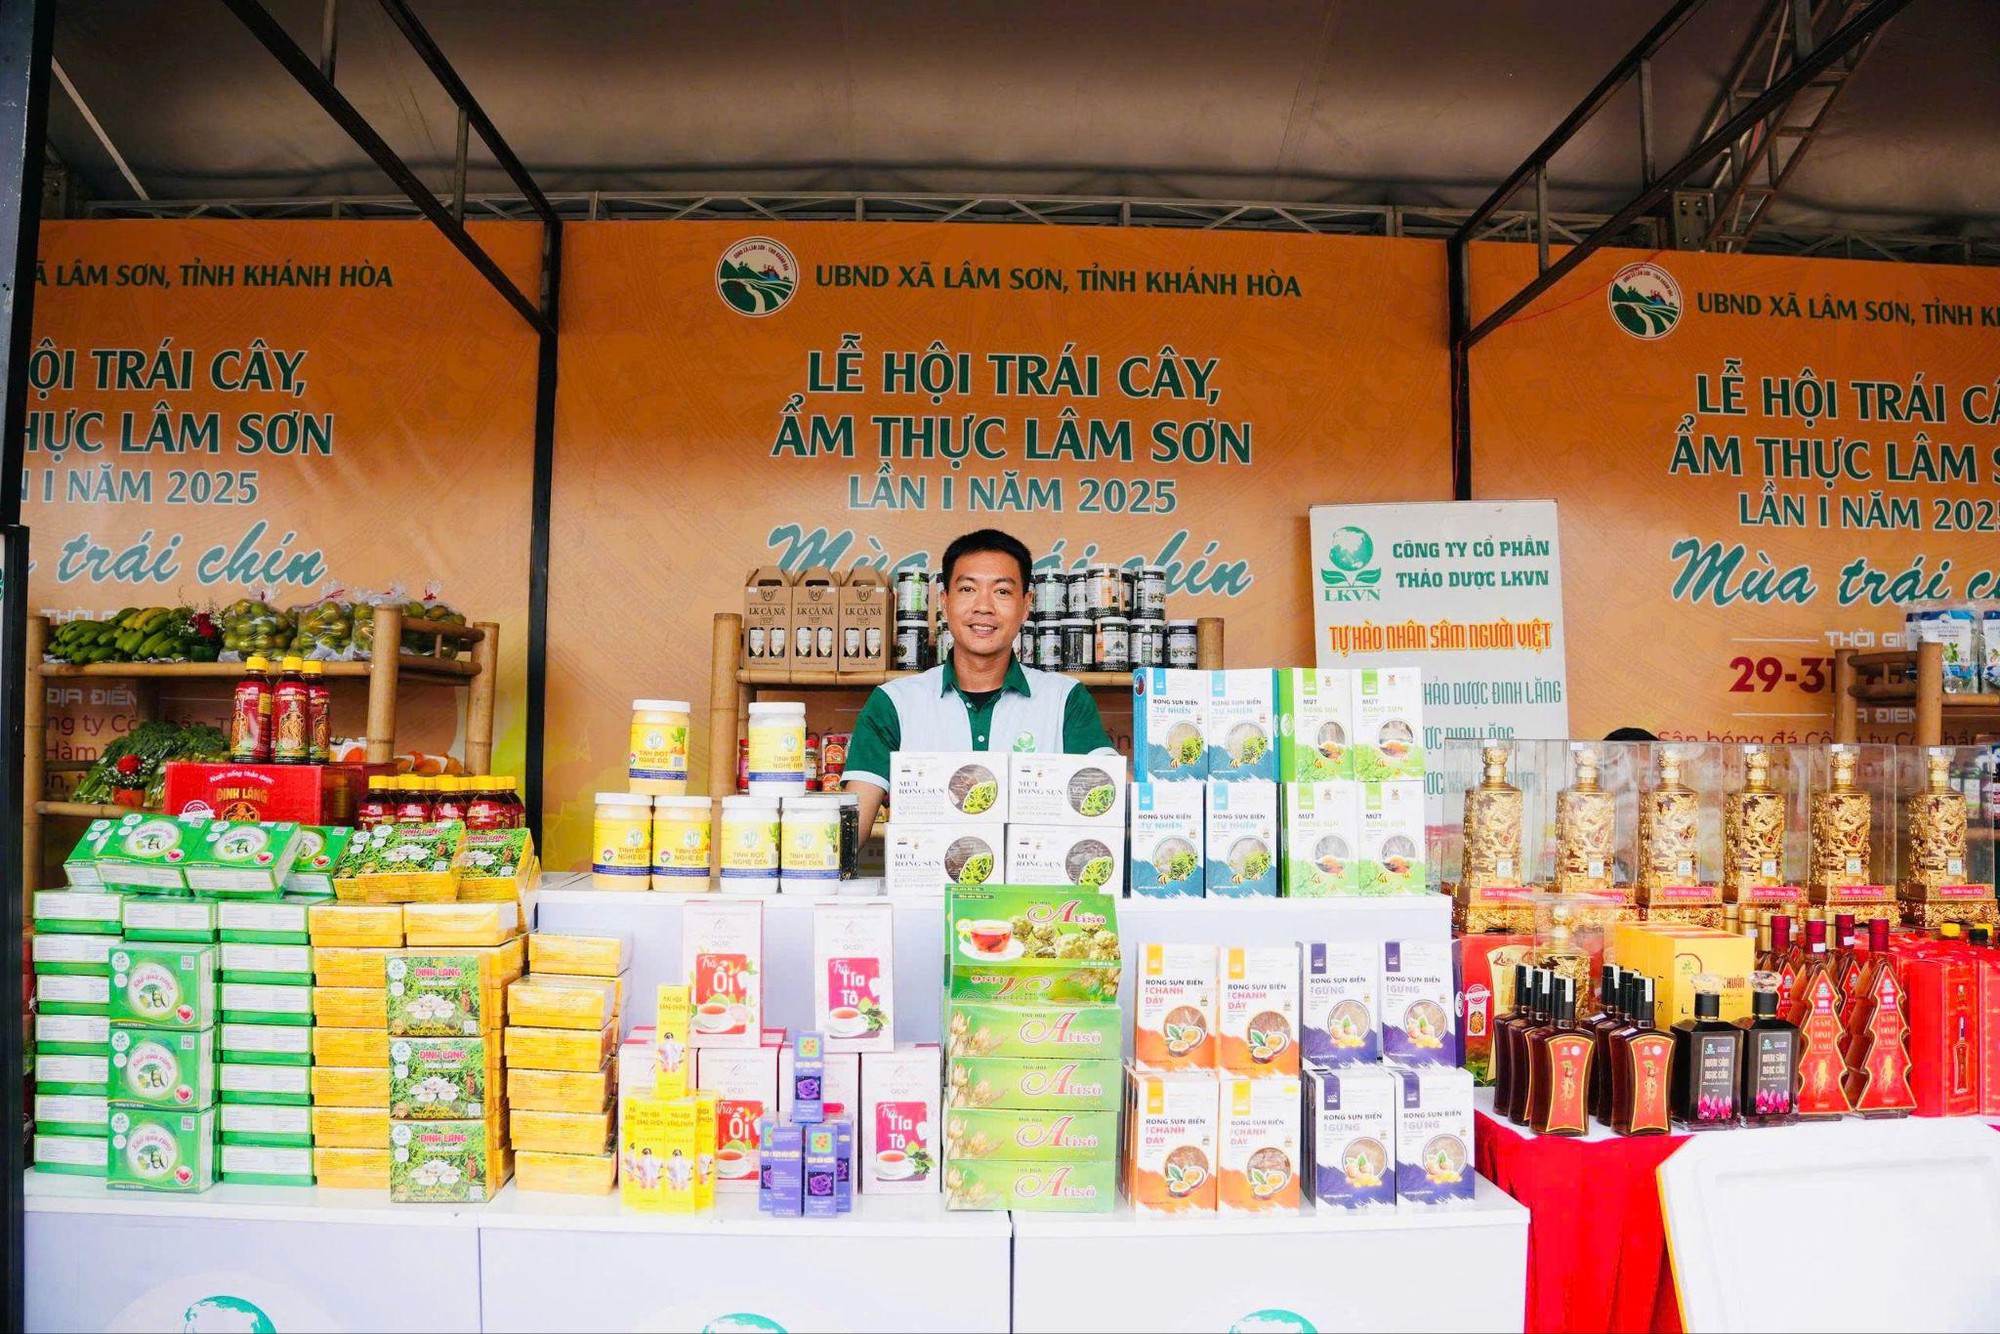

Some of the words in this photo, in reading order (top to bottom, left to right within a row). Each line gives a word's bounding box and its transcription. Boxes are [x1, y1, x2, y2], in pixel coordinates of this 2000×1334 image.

[34, 260, 48, 286] Ã
[57, 259, 108, 286] LÂM
[116, 264, 170, 288] SƠN,
[180, 259, 235, 287] TỈNH
[243, 259, 331, 287] KHÁNH
[340, 260, 393, 288] HÒA
[815, 264, 889, 288] UBND
[898, 259, 936, 289] XÃ
[944, 260, 1001, 290] LÂM
[1009, 266, 1069, 294] SƠN,
[1077, 261, 1136, 293] TỈNH
[1146, 262, 1238, 296] KHÁNH
[1247, 267, 1301, 298] HÒA
[1697, 292, 1762, 316] UBND
[1769, 292, 1801, 318] XÃ
[1808, 292, 1858, 321] LÂM
[1864, 300, 1915, 327] SƠN,
[1922, 296, 1973, 326] TỈNH
[29, 338, 74, 399] ỘI
[92, 338, 194, 392] TRÁI
[211, 338, 308, 398] CÂY,
[807, 333, 864, 394] LỄ
[883, 341, 971, 404] HỘI
[987, 343, 1099, 397] TRÁI
[1118, 345, 1221, 405] CÂY,
[1695, 357, 1747, 416] LỄ
[1761, 367, 1838, 429] HỘI
[1850, 372, 1948, 425] TRÁI
[24, 408, 104, 463] HỰC
[120, 401, 220, 454] LÂM
[236, 411, 334, 456] SƠN
[770, 393, 853, 458] ẨM
[873, 414, 1006, 468] THỰC
[1025, 408, 1133, 461] LÂM
[1151, 418, 1252, 464] SƠN
[1668, 413, 1743, 477] ẨM
[1755, 436, 1873, 490] THỰC
[1885, 432, 1978, 485] LÂM
[43, 470, 54, 503] I
[66, 462, 152, 503] NĂM
[166, 470, 258, 505] 2025
[847, 465, 928, 511] LẦN
[940, 476, 954, 510] I
[968, 472, 1062, 512] NĂM
[1078, 478, 1177, 514] 2025
[1738, 480, 1806, 528] LẦN
[1818, 494, 1829, 528] I
[1841, 491, 1921, 530] NĂM
[1932, 499, 2000, 532] 202
[57, 528, 183, 584] trái
[196, 519, 328, 588] chín
[1393, 540, 1440, 558] CÔNG
[1445, 542, 1467, 557] TY
[1473, 534, 1494, 557] CỔ
[1500, 534, 1550, 557] PHẦN
[1396, 568, 1443, 588] THẢO
[1449, 571, 1495, 590] DƯỢC
[1502, 570, 1549, 586] LKVN
[1669, 535, 1818, 607] Mùa
[1836, 554, 1953, 607] trái
[1324, 589, 1381, 602] LKVN
[1329, 626, 1349, 656] TỰ
[1352, 619, 1382, 651] HÀO
[1386, 619, 1427, 650] NHÂN
[1430, 619, 1465, 649] SÂM
[1469, 617, 1514, 649] NGƯỜI
[1517, 618, 1552, 654] VIỆT
[1824, 628, 1875, 648] THỜI
[47, 687, 82, 707] ĐỊA
[1424, 676, 1450, 705] HẢO
[1454, 680, 1488, 709] DƯỢC
[1492, 682, 1523, 705] ĐINH
[1526, 676, 1561, 704] LĂNG
[48, 716, 75, 735] ng
[83, 715, 104, 737] ty
